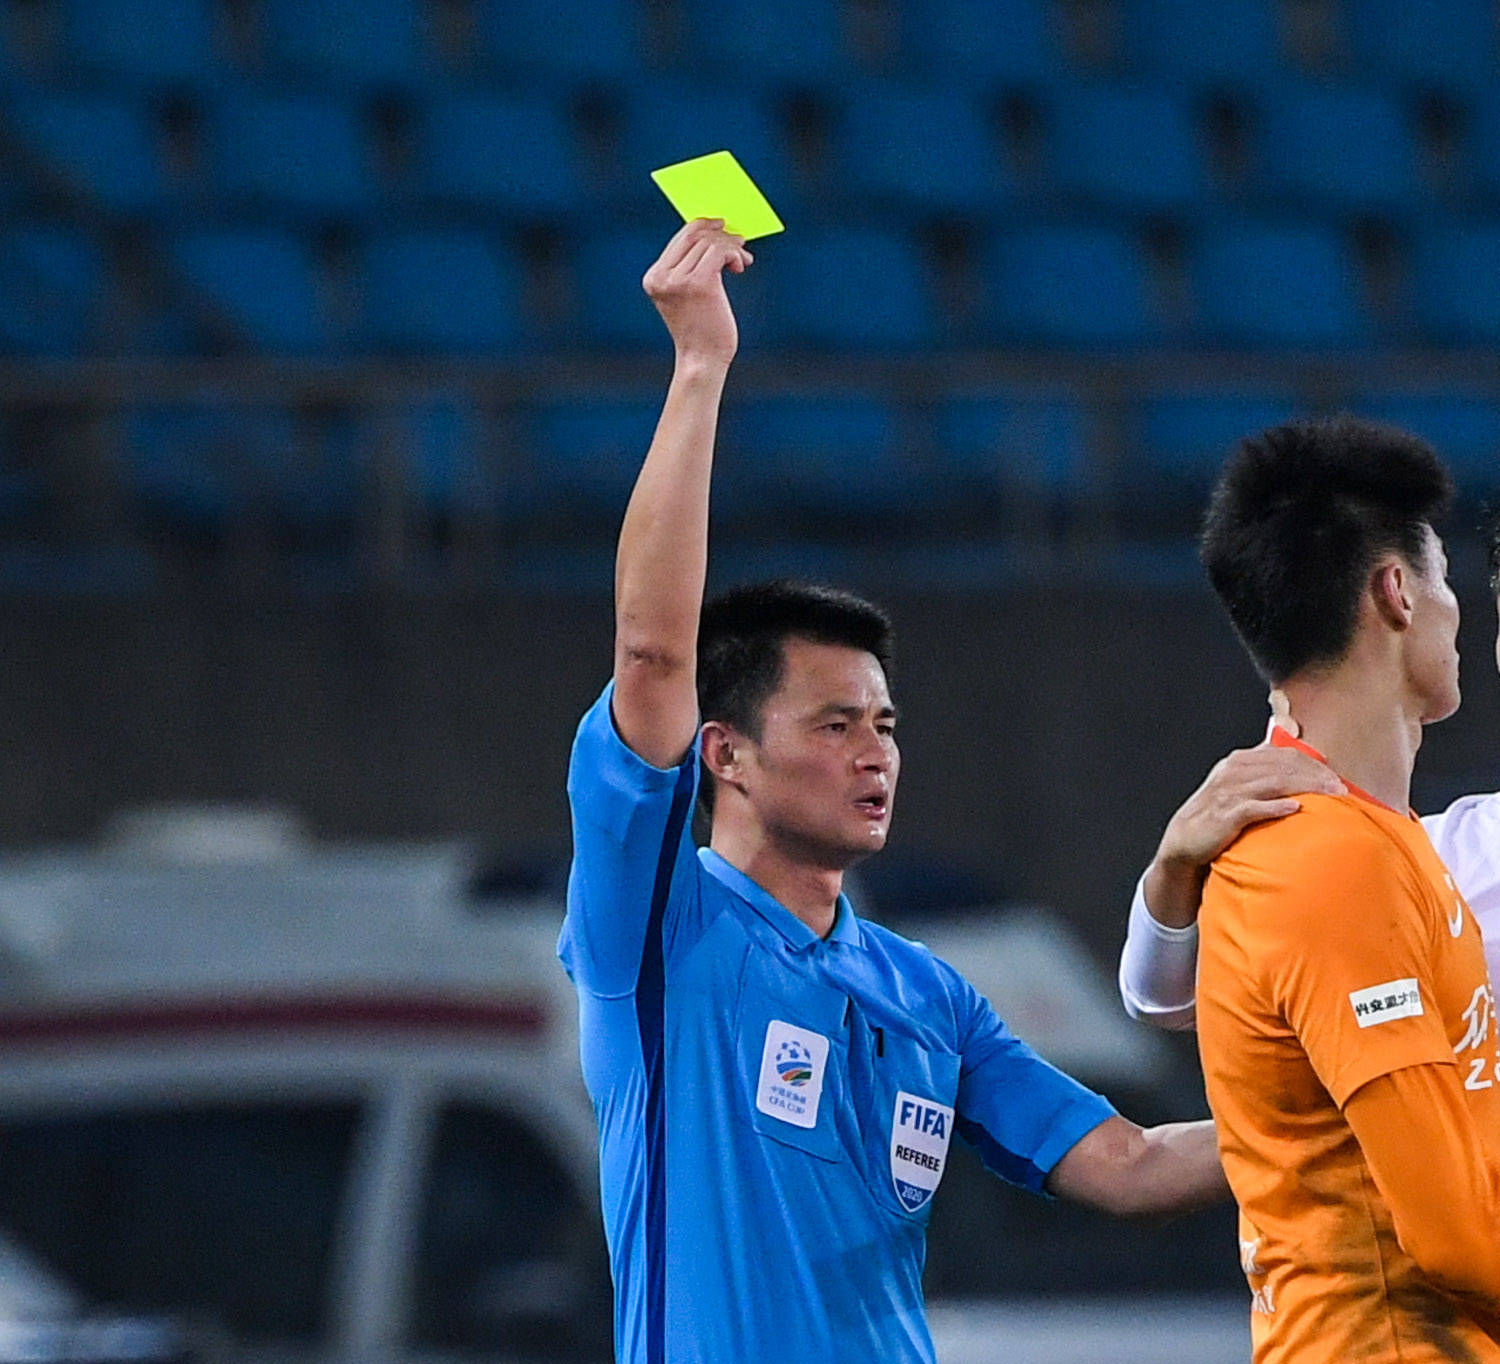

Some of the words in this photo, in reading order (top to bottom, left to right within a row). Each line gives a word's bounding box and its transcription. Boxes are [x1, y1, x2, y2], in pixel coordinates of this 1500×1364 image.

[900, 1101, 945, 1139] FIFA
[895, 1144, 941, 1172] REFEREE
[901, 1185, 922, 1202] 2020
